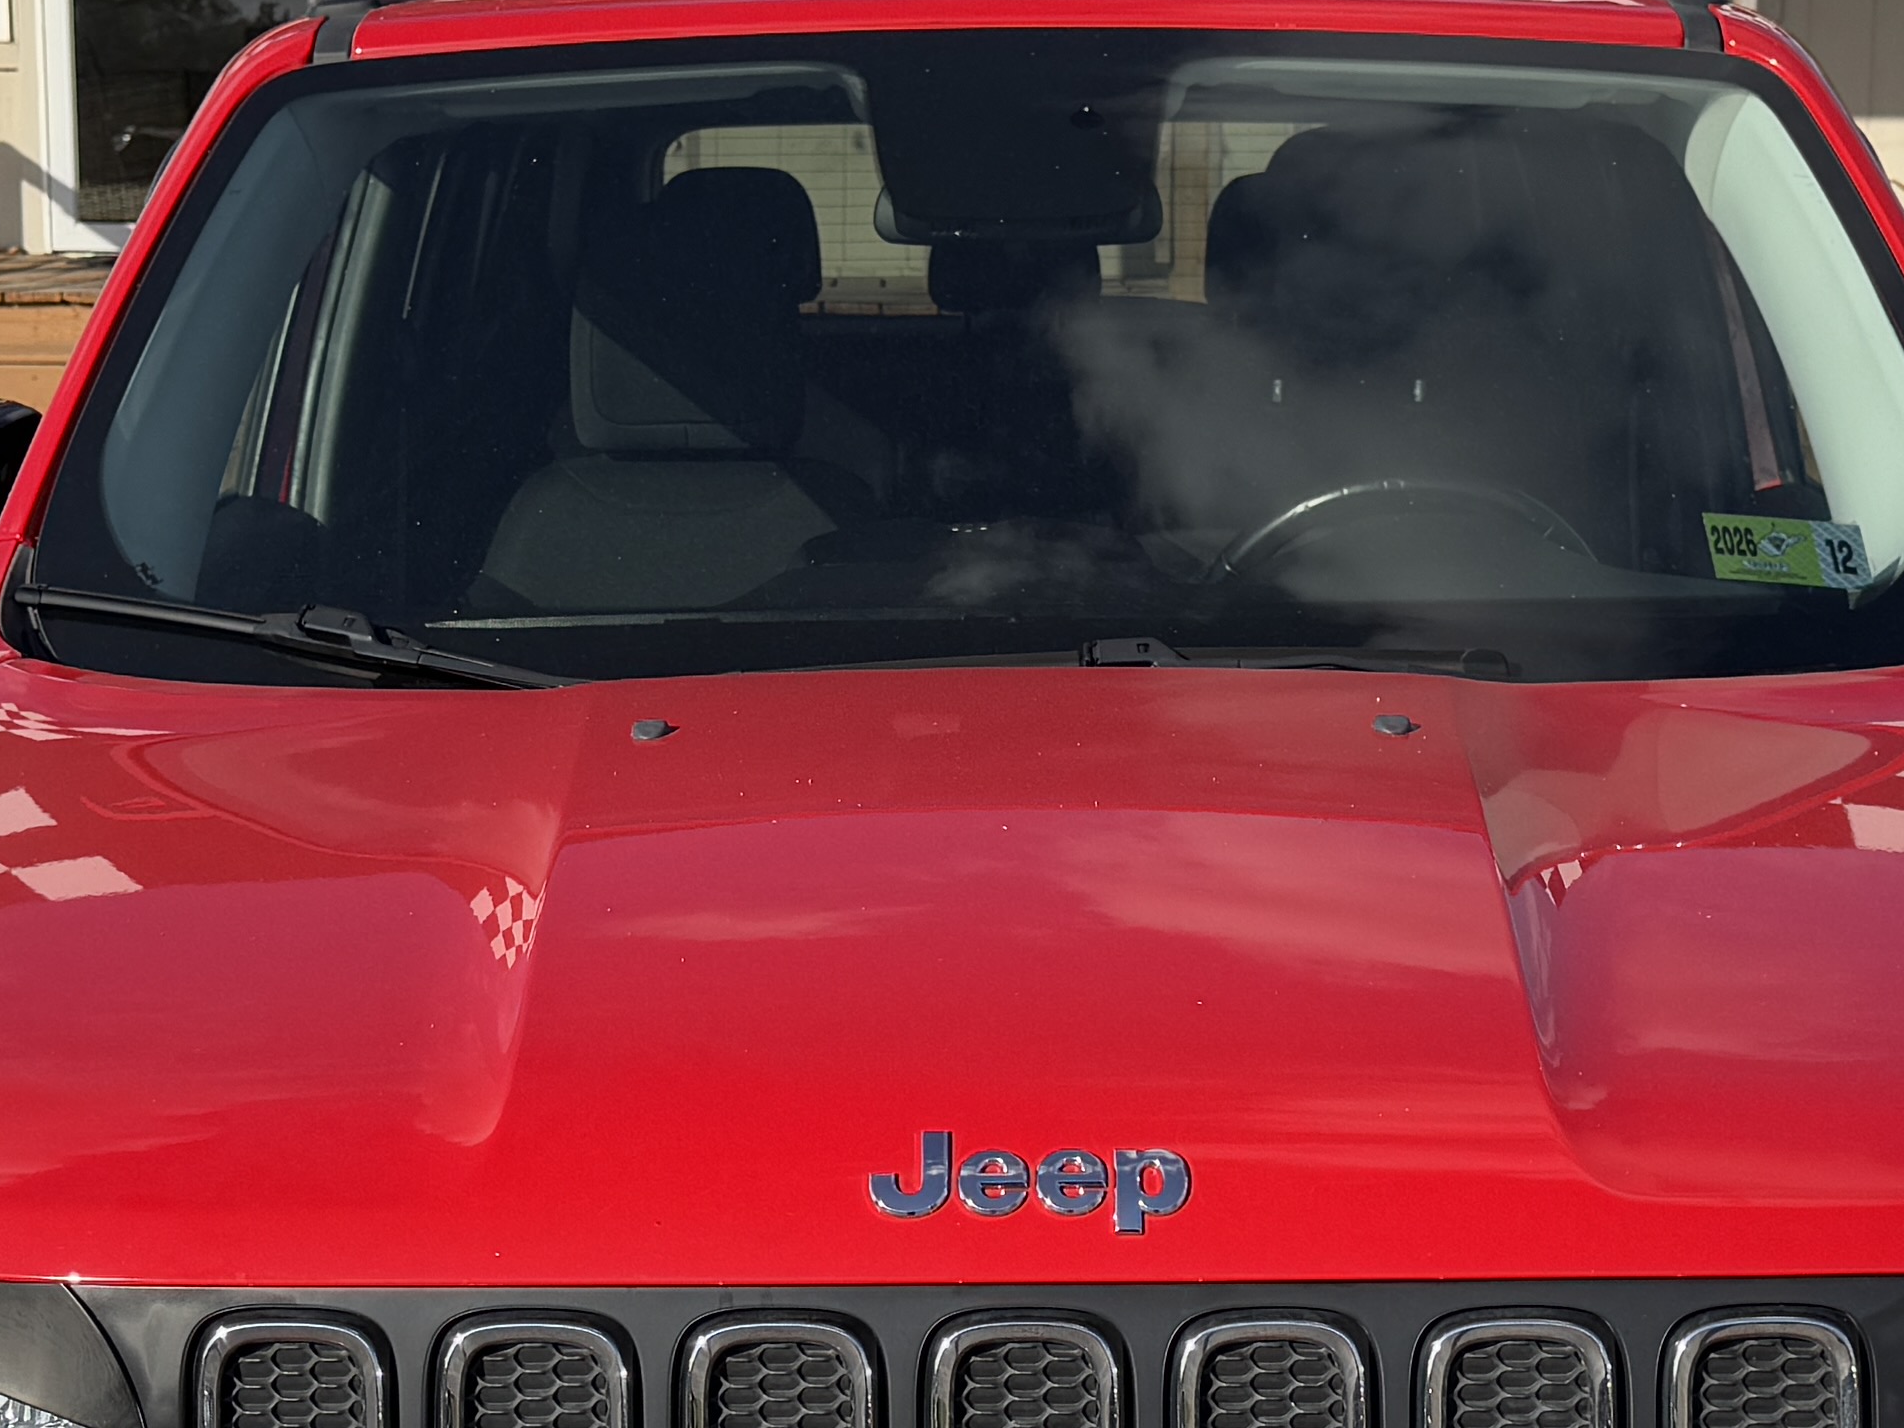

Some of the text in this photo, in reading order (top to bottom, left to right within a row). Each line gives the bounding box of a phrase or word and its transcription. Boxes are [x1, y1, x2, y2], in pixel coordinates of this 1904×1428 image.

[1711, 525, 1758, 558] 2026
[1825, 538, 1859, 576] 12
[868, 1130, 1192, 1236] Jeep
